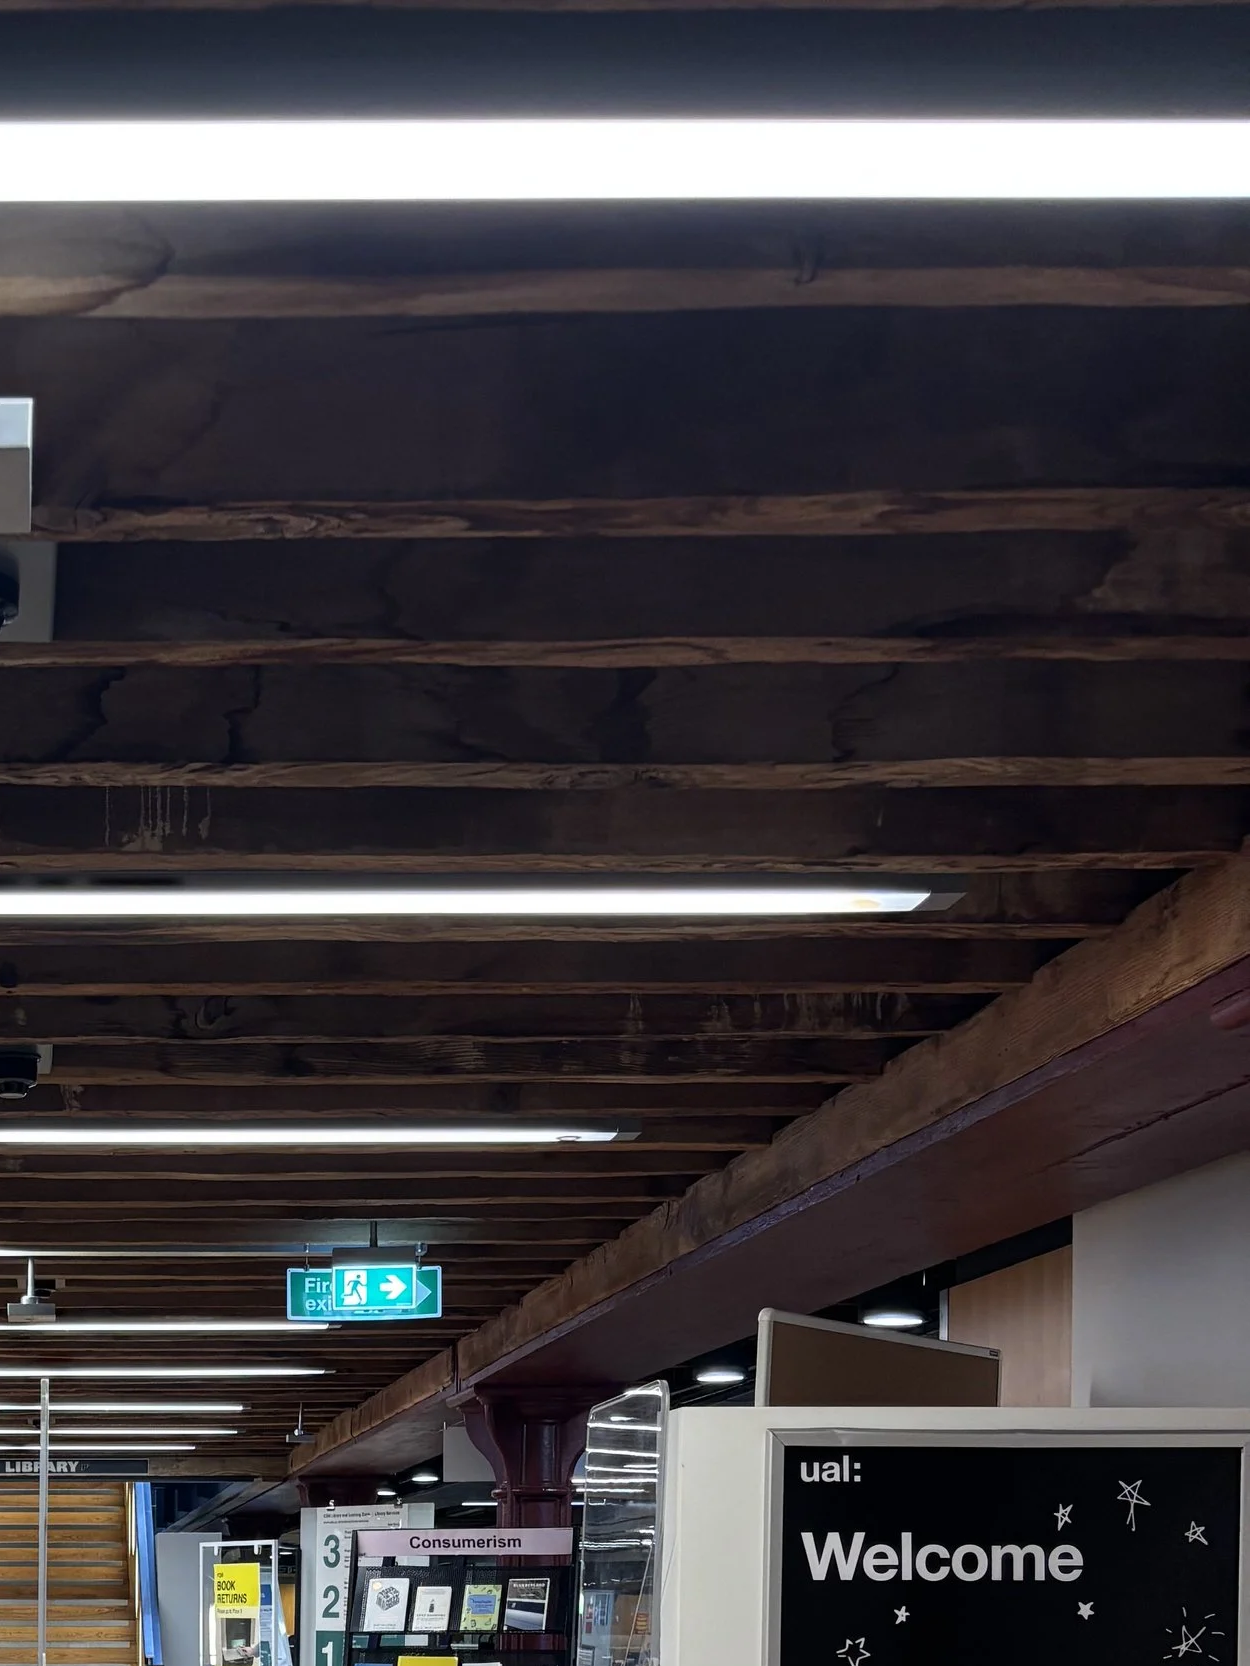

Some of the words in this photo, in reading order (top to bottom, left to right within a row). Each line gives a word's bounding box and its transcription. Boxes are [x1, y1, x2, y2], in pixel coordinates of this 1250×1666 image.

[305, 1278, 332, 1293] Fir
[305, 1296, 331, 1311] exi
[800, 1455, 861, 1482] ual:
[409, 1535, 521, 1549] Consumerism
[323, 1535, 340, 1568] 3
[800, 1532, 1084, 1582] Welcome
[217, 1581, 235, 1591] BOOK
[217, 1593, 247, 1604] RETURNS
[322, 1585, 340, 1618] 2
